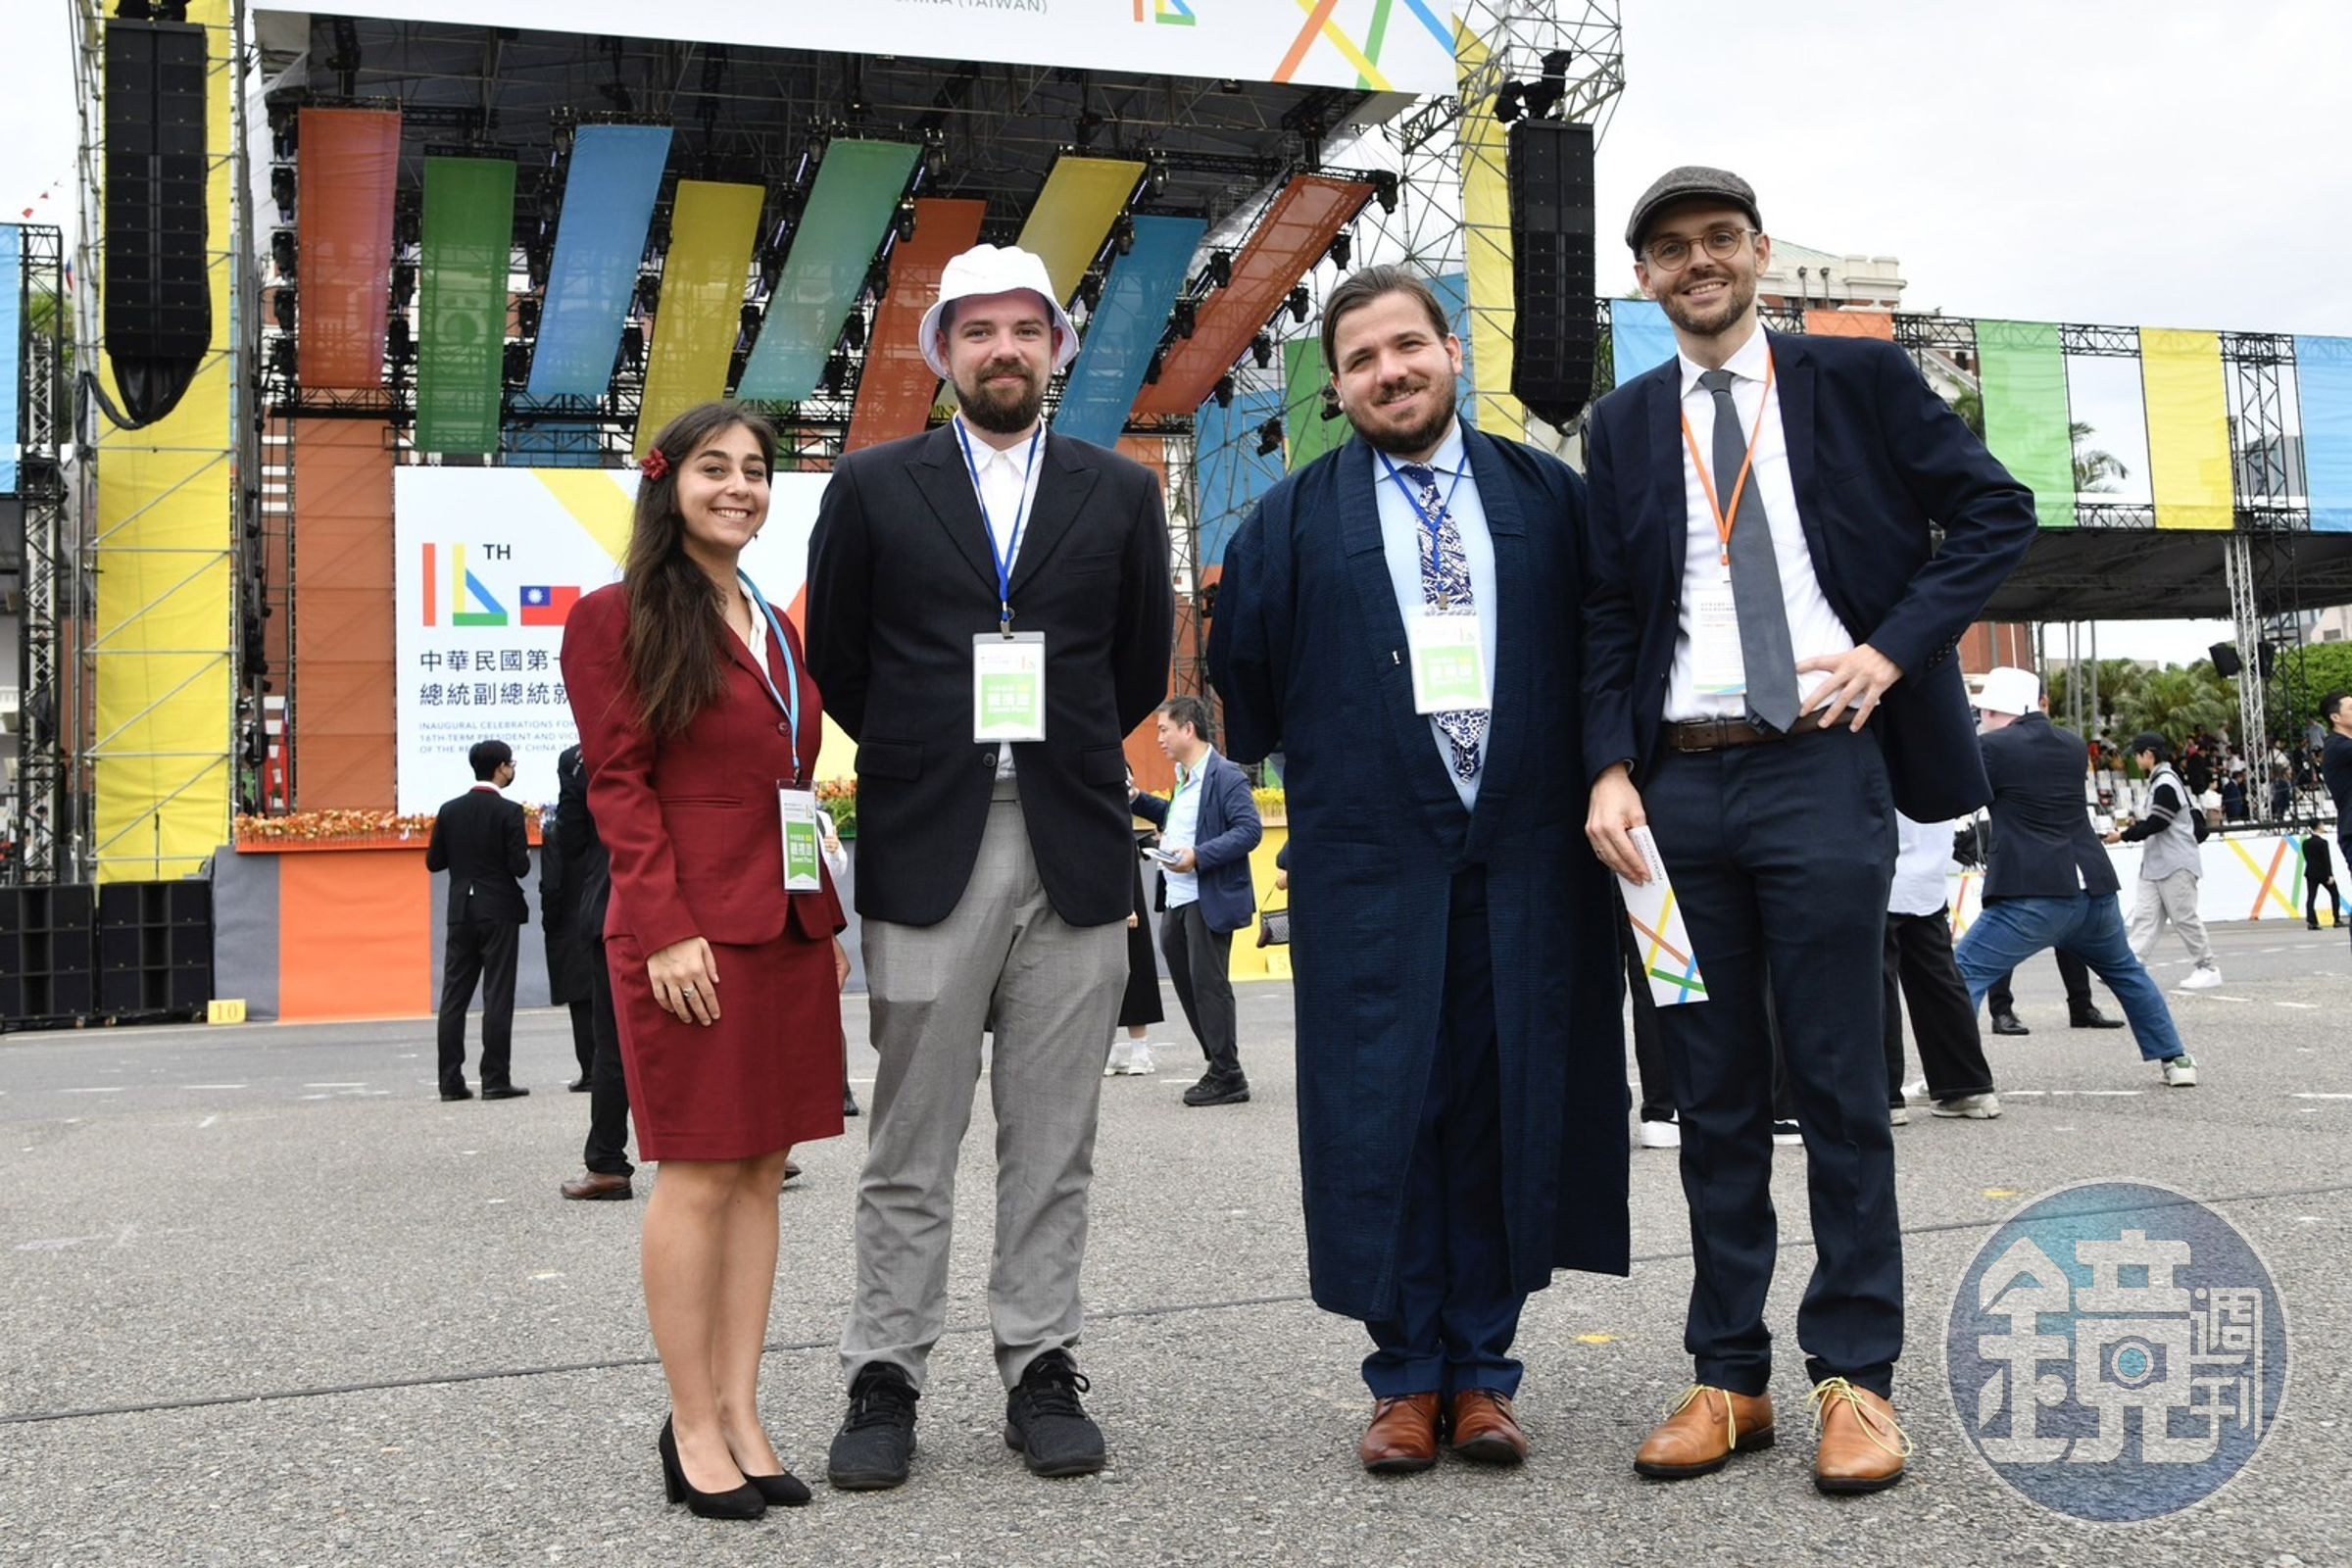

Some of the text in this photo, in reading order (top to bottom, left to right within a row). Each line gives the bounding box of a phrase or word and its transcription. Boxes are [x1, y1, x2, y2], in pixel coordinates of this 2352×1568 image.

[482, 544, 512, 560] TH
[419, 721, 477, 730] INAUGURAL
[480, 720, 553, 729] CELEBRATIONS
[419, 745, 432, 754] OF
[436, 745, 455, 754] THE
[217, 1003, 238, 1021] 10
